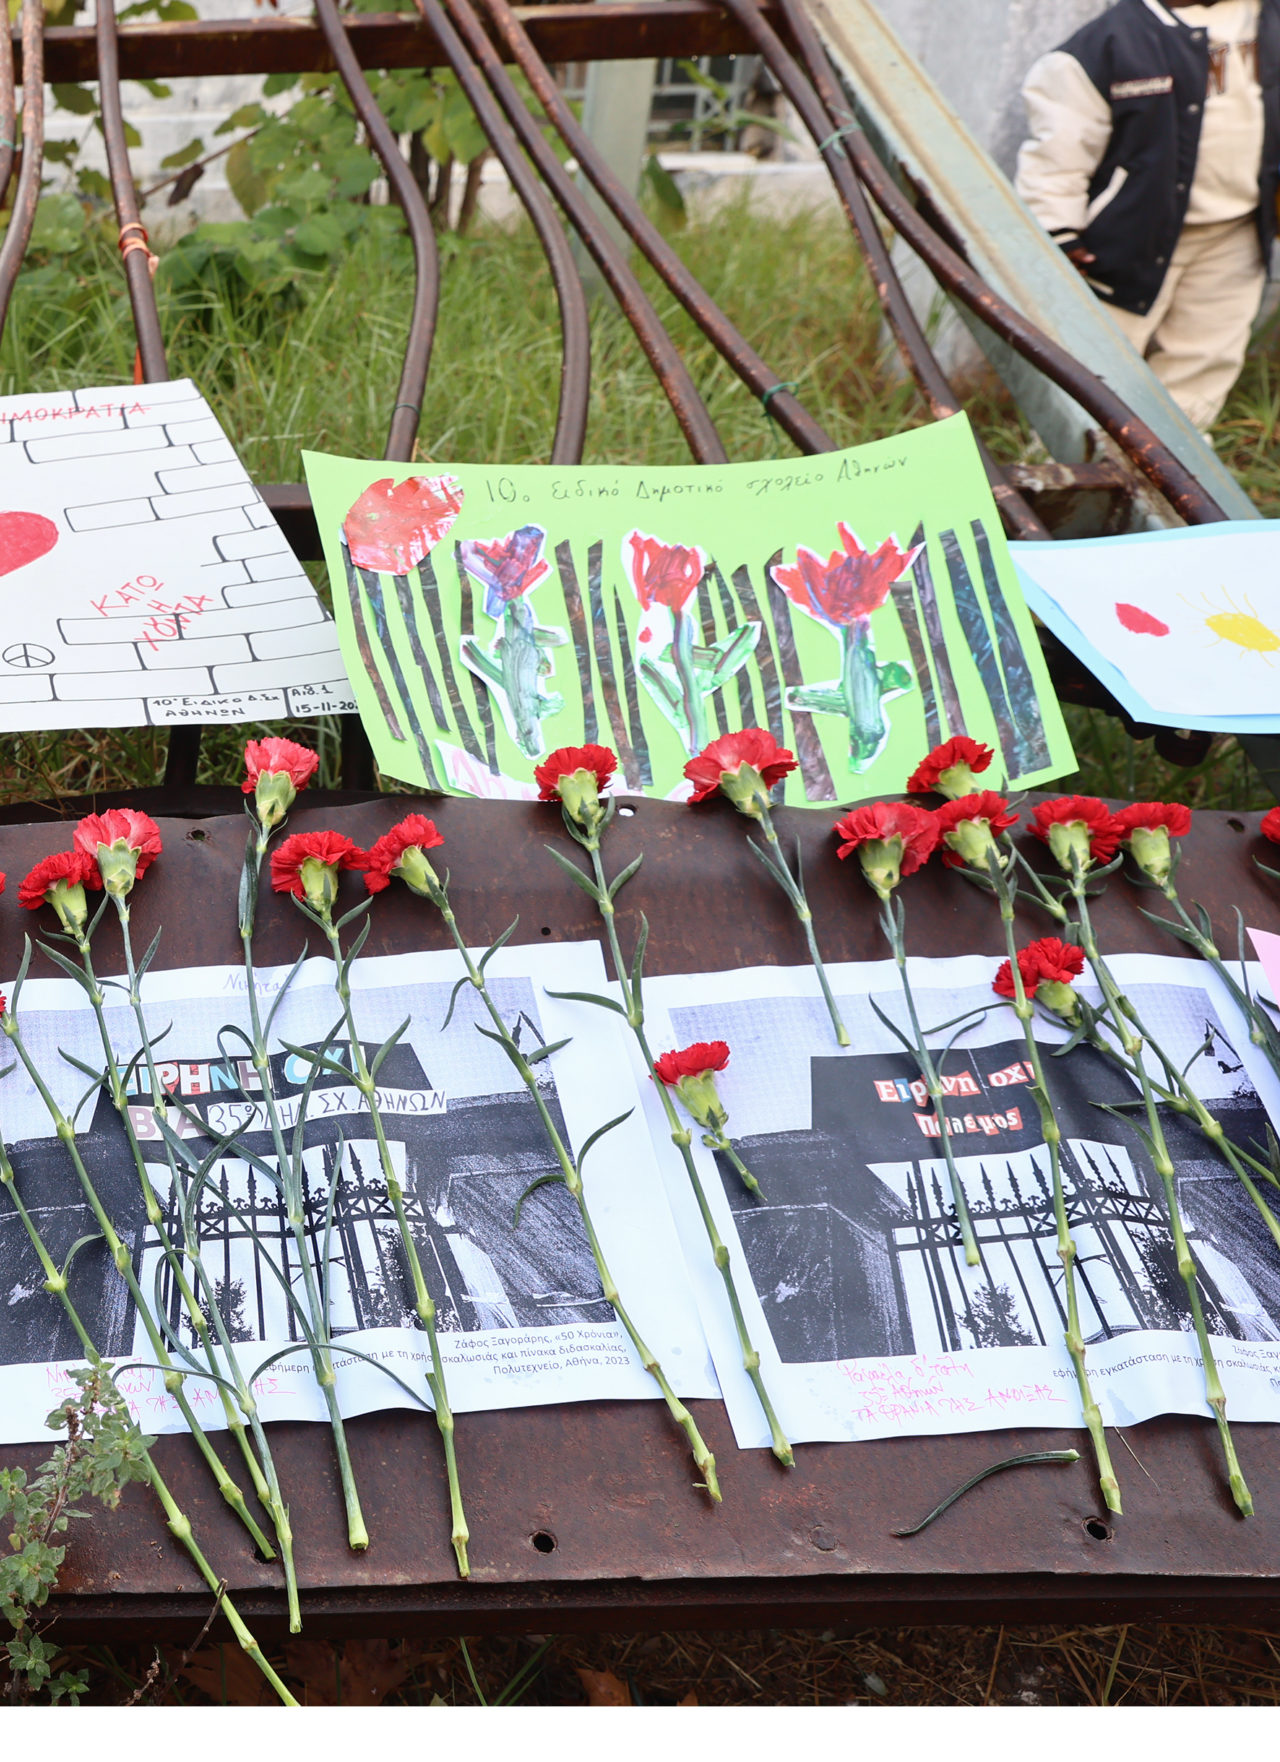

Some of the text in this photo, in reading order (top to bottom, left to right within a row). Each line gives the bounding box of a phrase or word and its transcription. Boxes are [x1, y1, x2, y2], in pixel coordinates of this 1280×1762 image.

[296, 700, 359, 713] 15-11-20
[454, 1339, 488, 1350] Ζάφος
[501, 1349, 518, 1360] και
[520, 1346, 557, 1358] πίνακα
[494, 1356, 630, 1375] Πολυτεχνείο, Αθήνα, 2023
